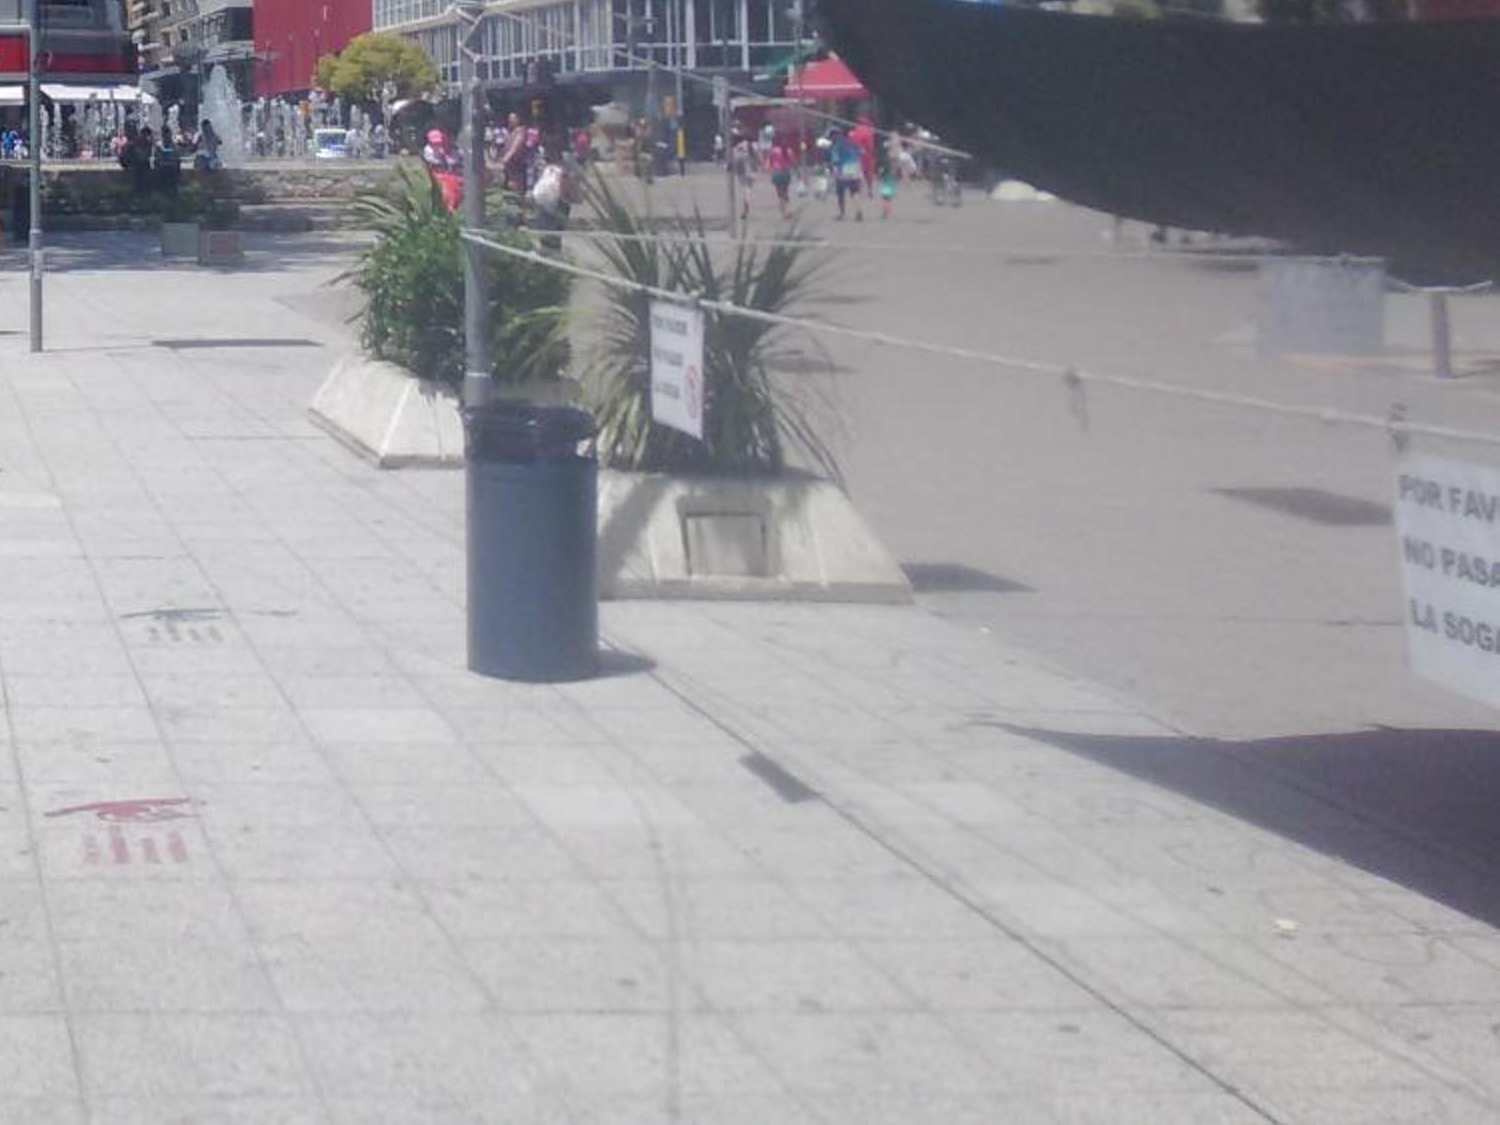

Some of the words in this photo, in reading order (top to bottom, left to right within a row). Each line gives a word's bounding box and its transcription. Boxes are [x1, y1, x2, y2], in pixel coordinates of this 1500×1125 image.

[1399, 474, 1444, 510] POR
[1404, 536, 1435, 571] NO
[1411, 597, 1439, 635] LA
